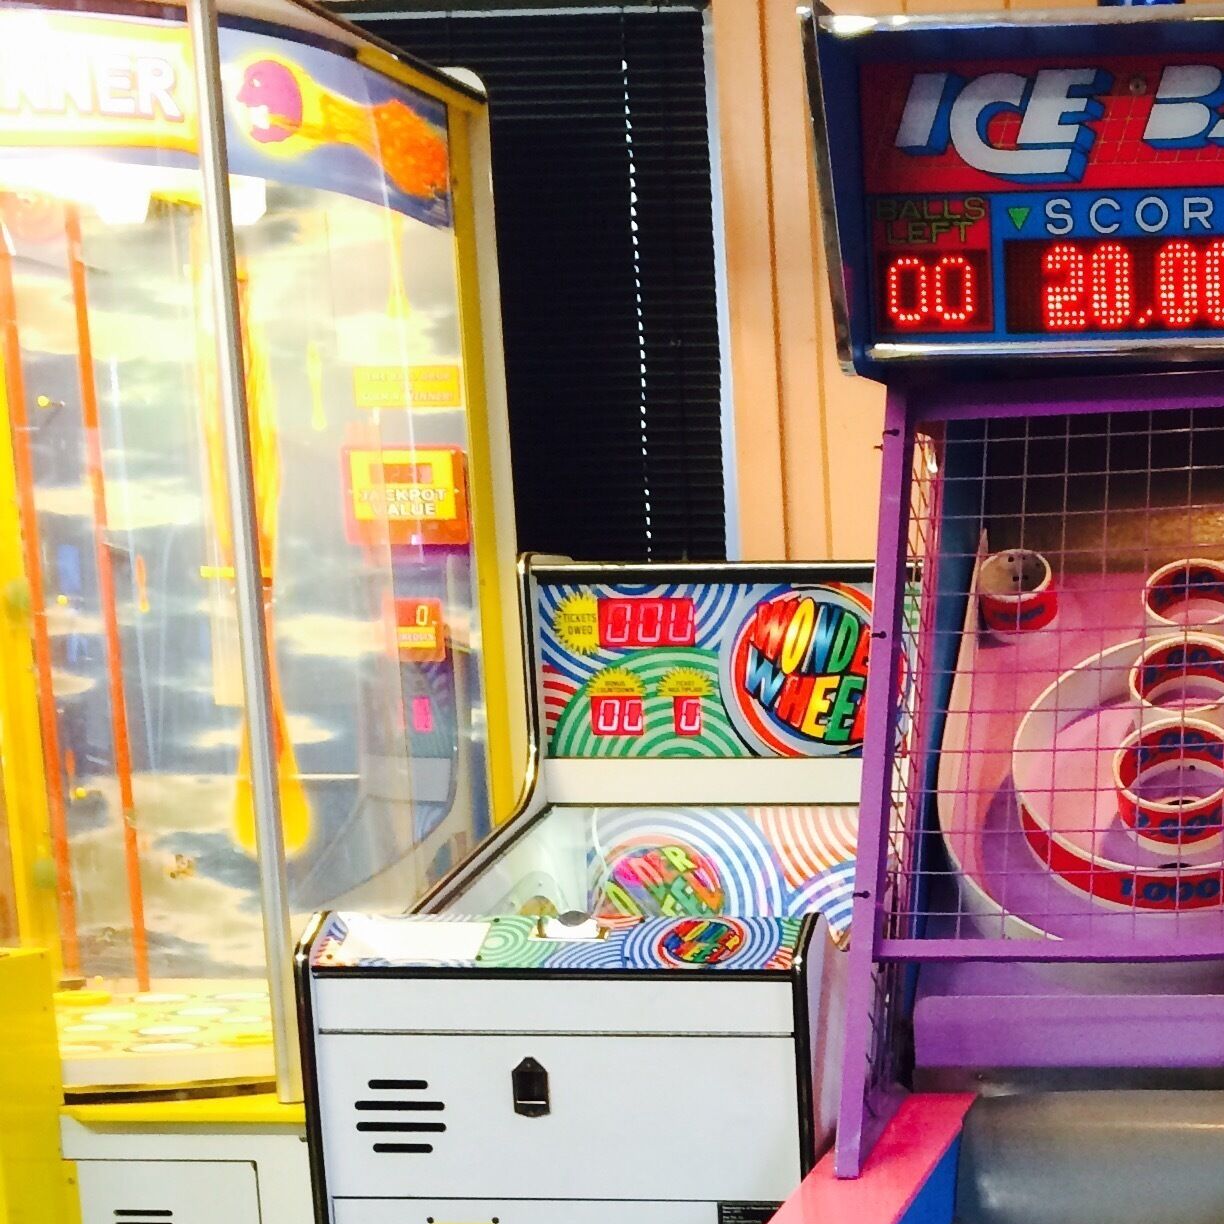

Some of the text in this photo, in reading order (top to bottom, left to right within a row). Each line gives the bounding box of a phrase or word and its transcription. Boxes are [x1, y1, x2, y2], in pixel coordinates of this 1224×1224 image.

[895, 67, 1108, 180] ICE
[877, 197, 986, 221] BALLS
[886, 220, 974, 244] LEFT
[889, 257, 975, 322] 00
[563, 613, 597, 624] TICKETS
